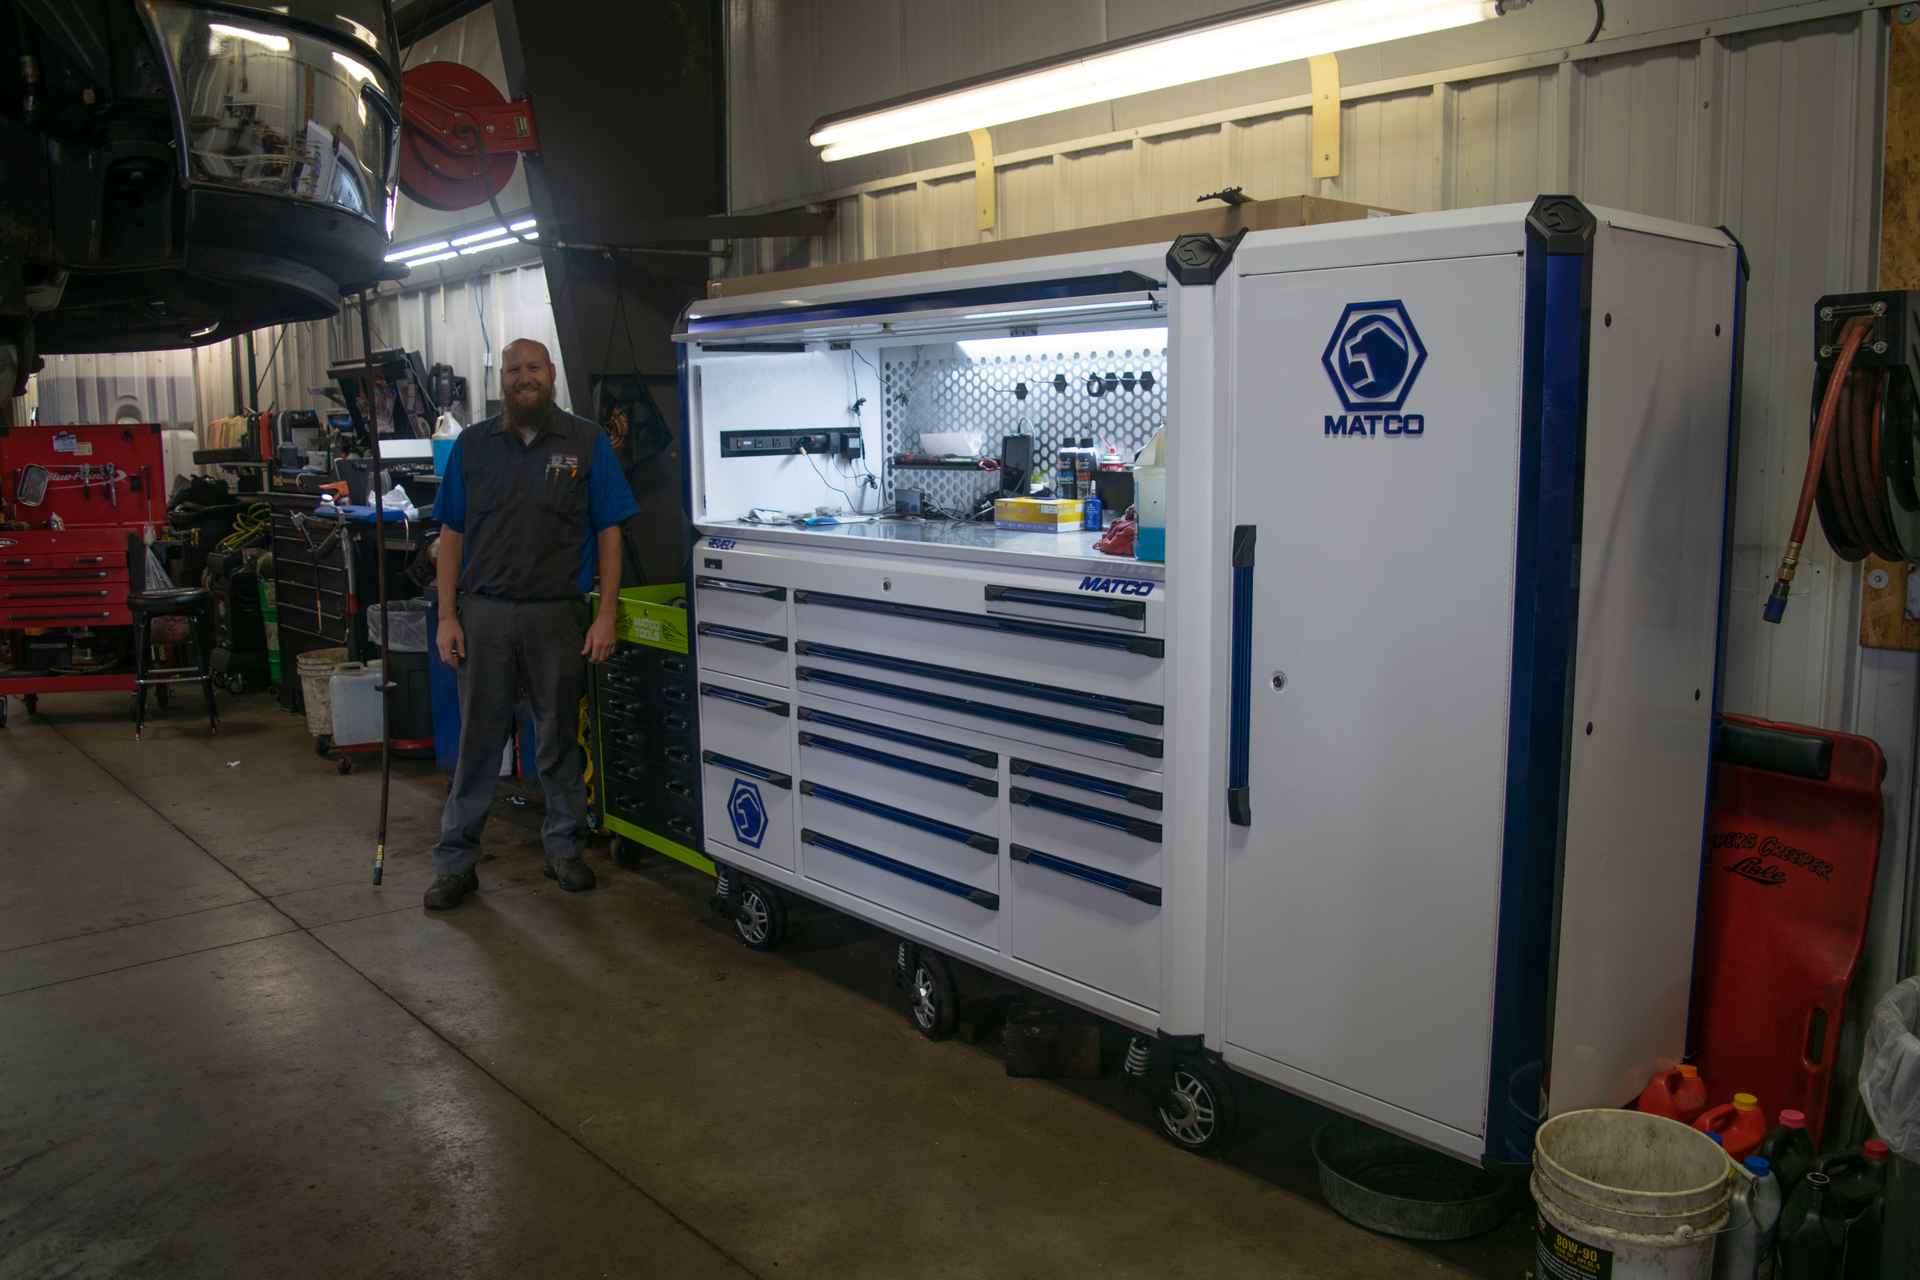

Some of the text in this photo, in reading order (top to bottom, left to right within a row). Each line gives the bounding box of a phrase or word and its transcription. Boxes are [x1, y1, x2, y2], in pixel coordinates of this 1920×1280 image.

[1324, 414, 1424, 435] MATCO
[1079, 576, 1154, 596] MATCO
[634, 616, 660, 631] MATCO
[634, 627, 660, 642] TOOLS
[1758, 836, 1833, 881] CREEPER
[1723, 857, 1786, 885] Lisle
[1556, 1234, 1598, 1262] 80W-90
